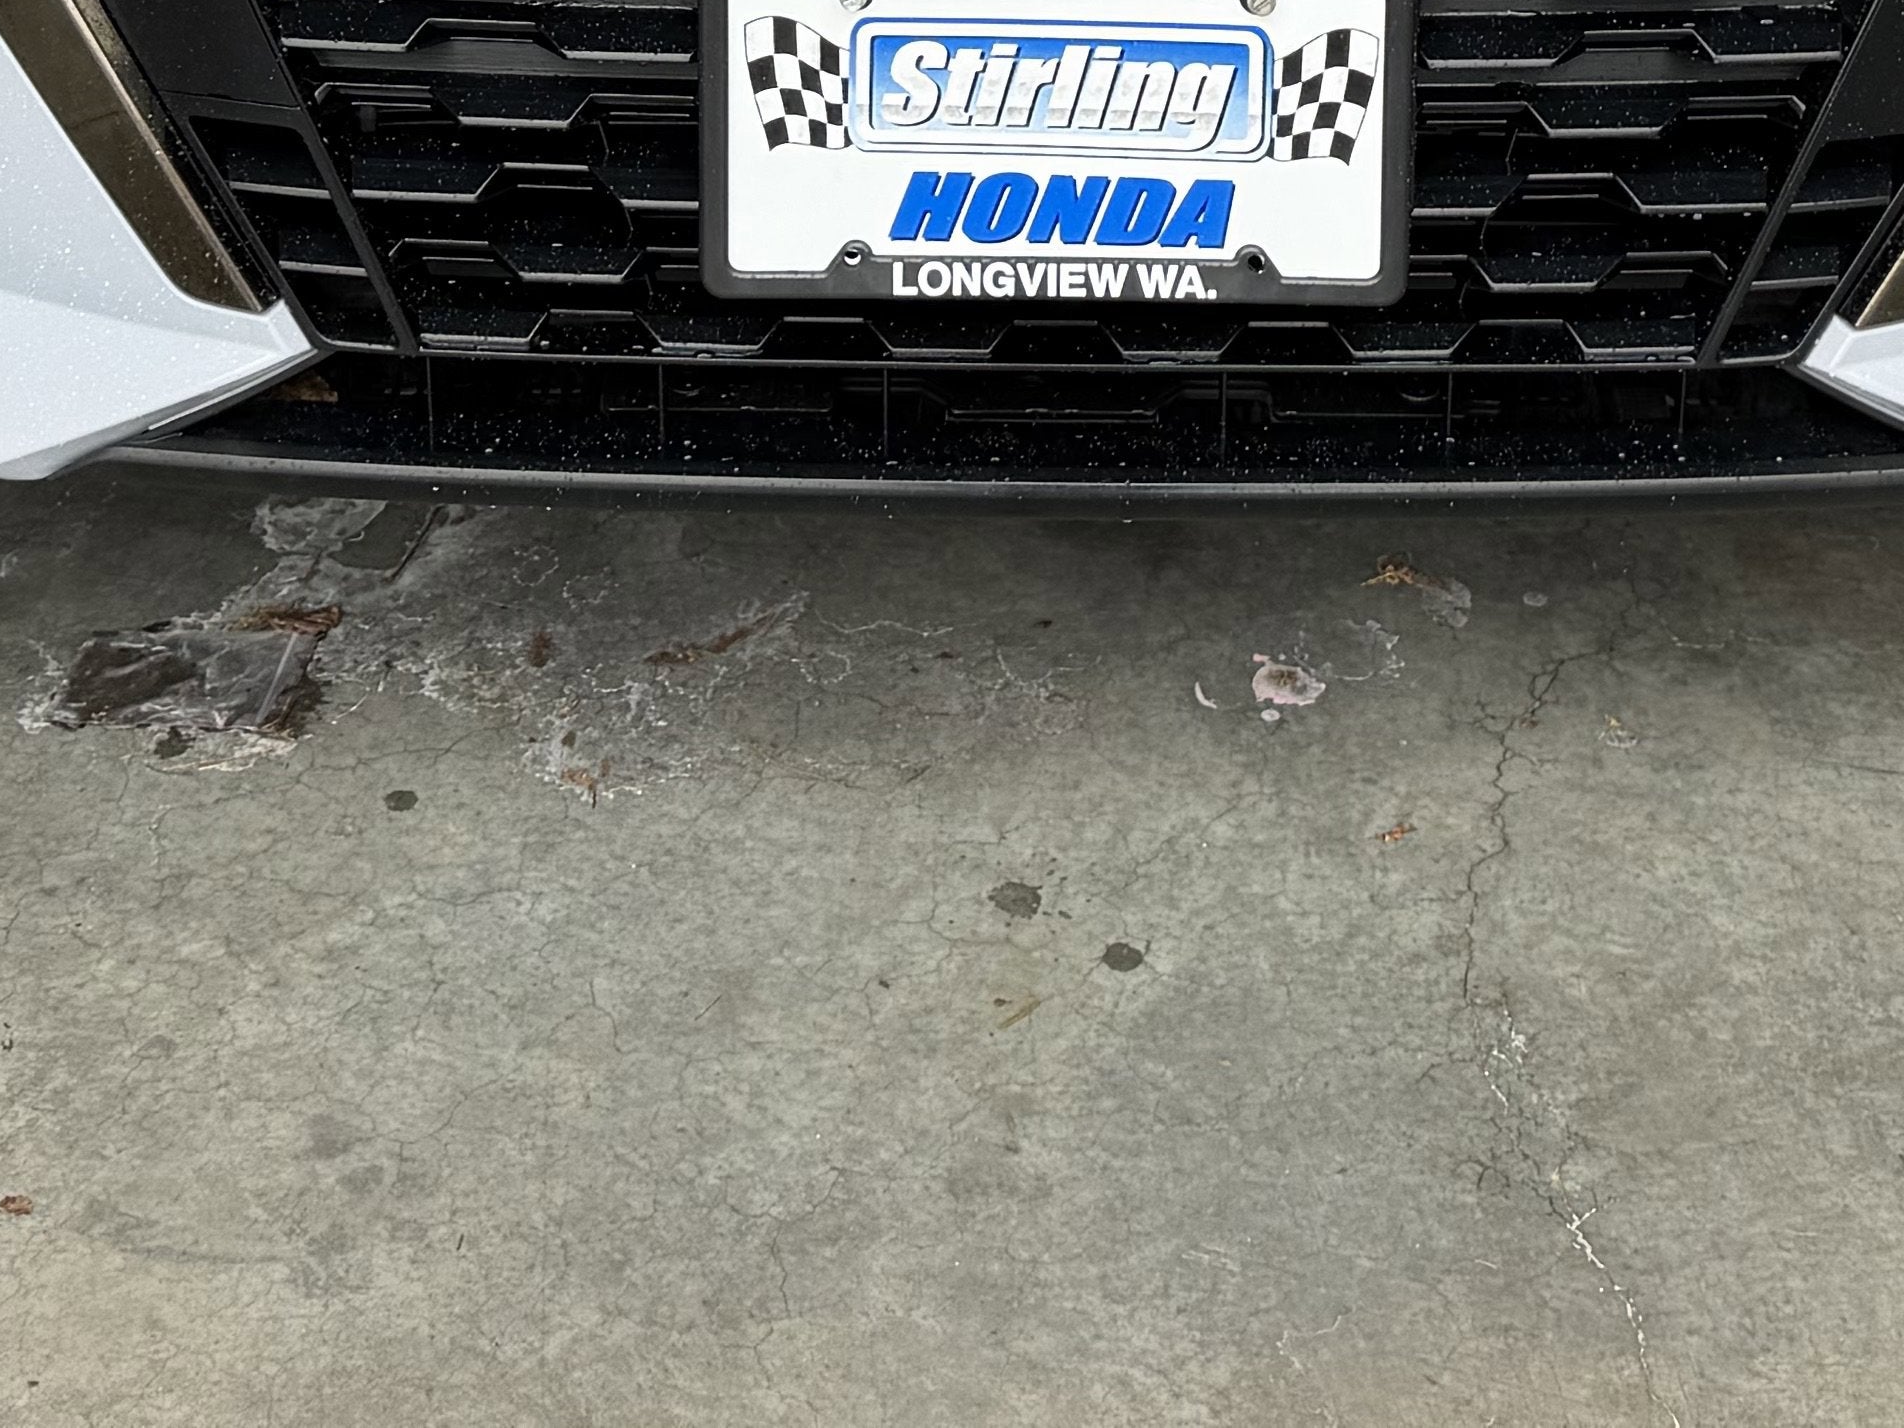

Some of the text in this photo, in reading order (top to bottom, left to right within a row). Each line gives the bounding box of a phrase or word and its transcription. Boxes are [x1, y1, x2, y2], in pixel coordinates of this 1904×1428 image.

[882, 40, 1239, 154] Stirling
[888, 172, 1236, 249] HONDA
[892, 261, 1217, 301] LONGVIEW WA.
